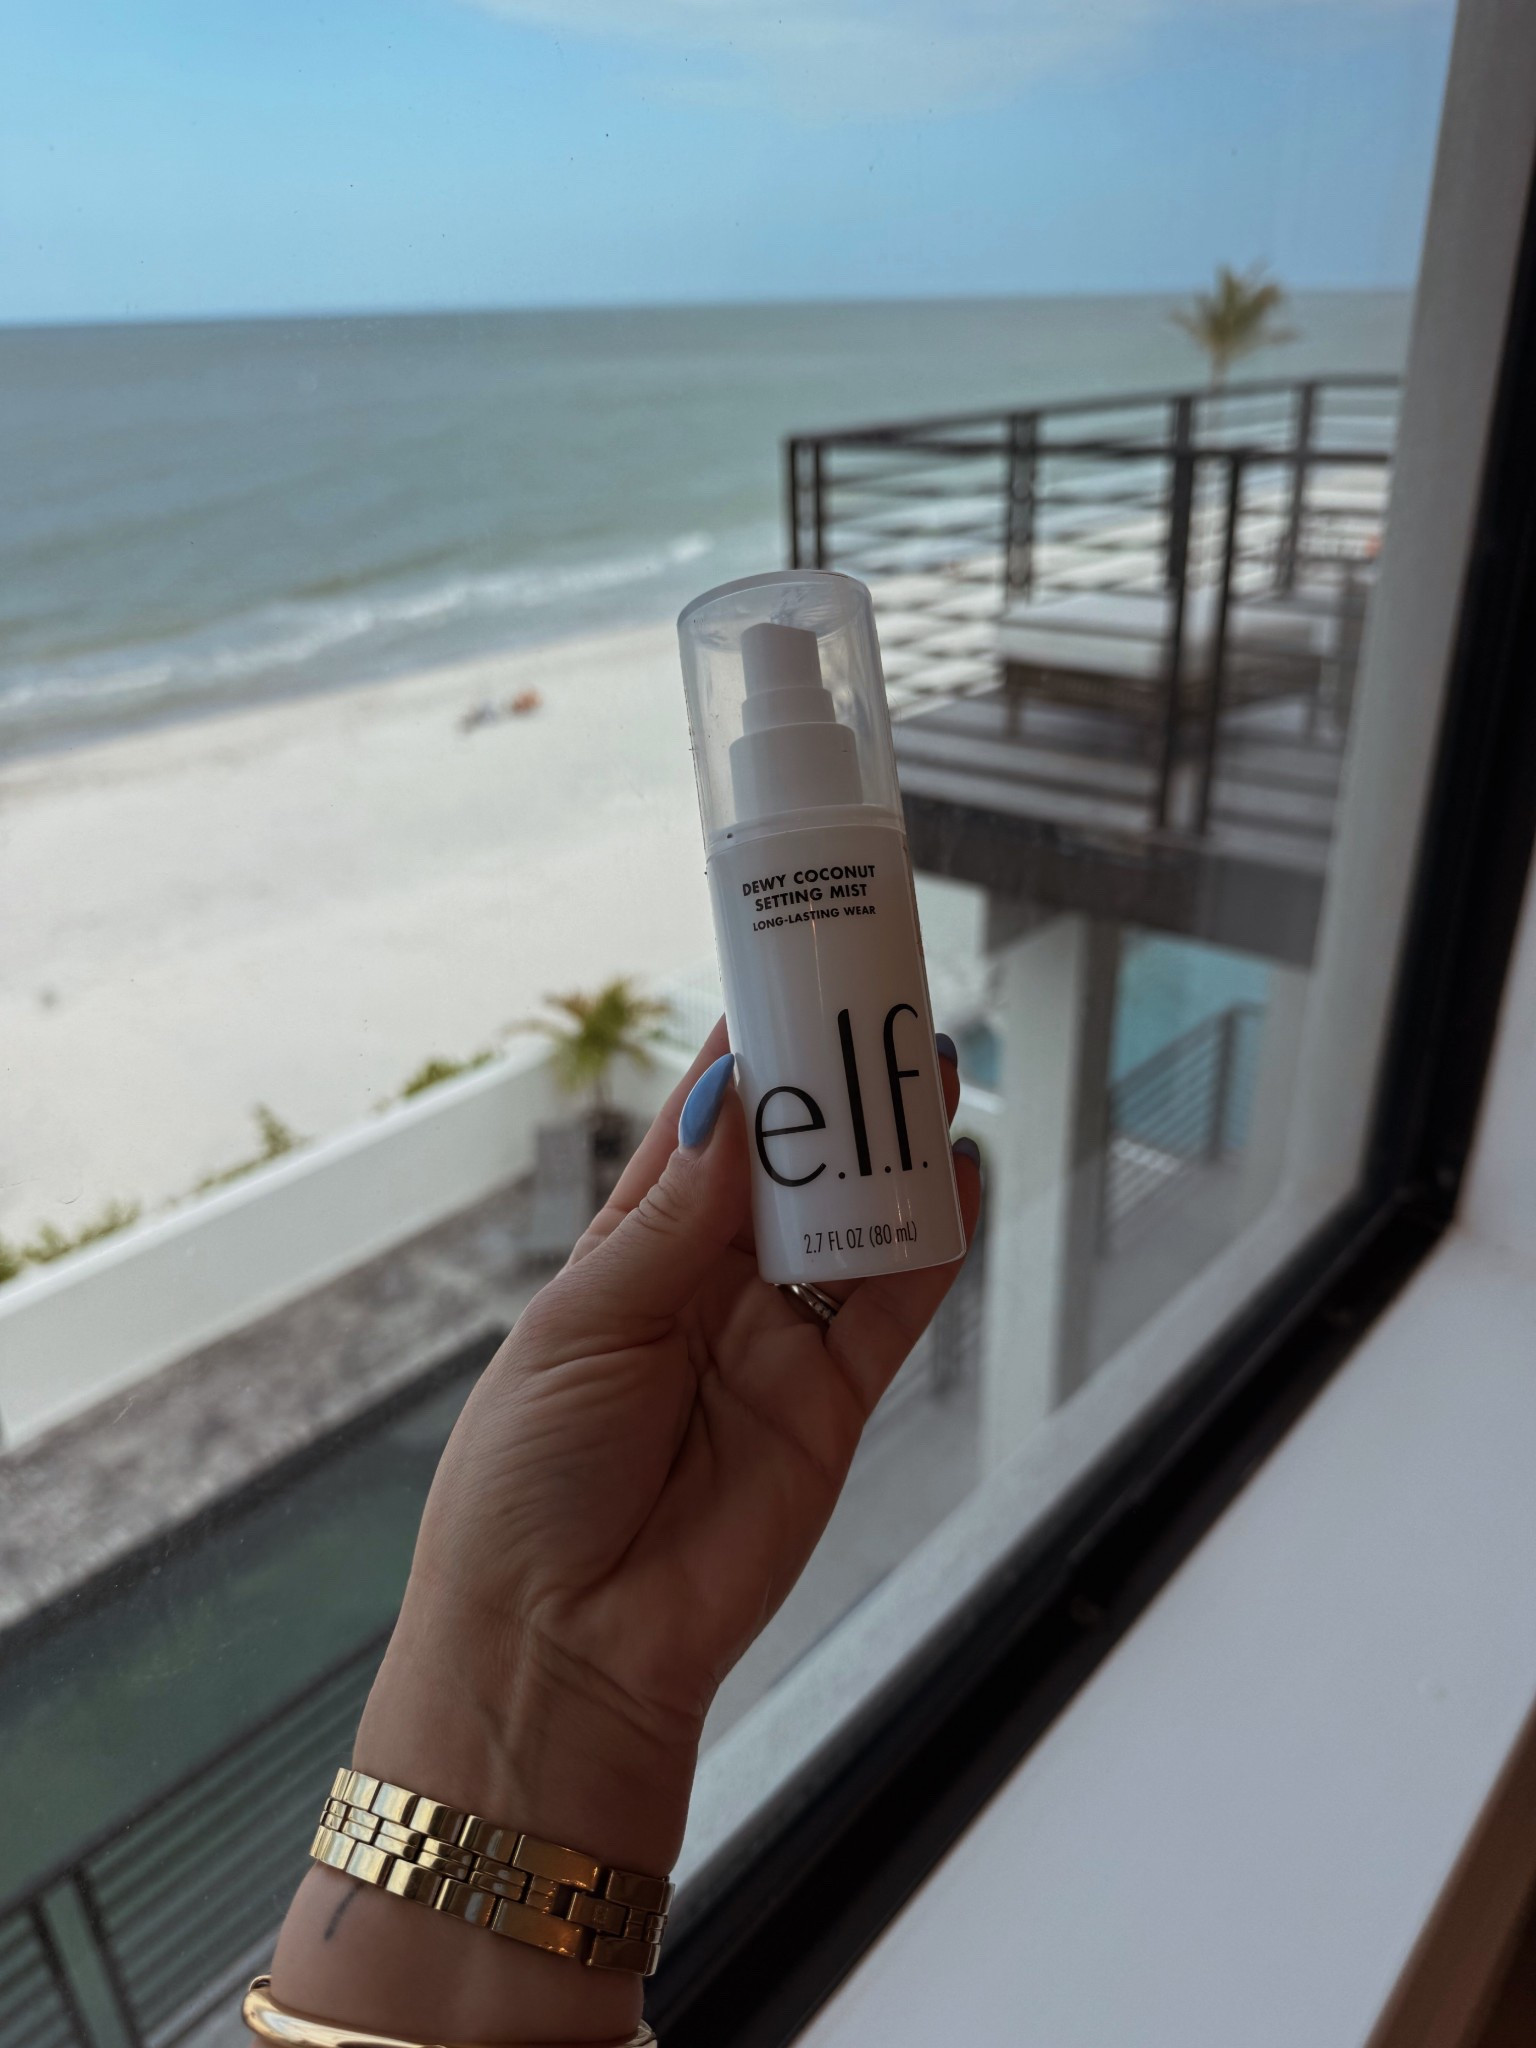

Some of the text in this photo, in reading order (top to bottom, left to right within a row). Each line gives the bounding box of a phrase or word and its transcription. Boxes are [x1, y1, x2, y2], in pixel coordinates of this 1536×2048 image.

[742, 865, 875, 896] DEWY COCONUT
[755, 883, 867, 912] SETTING MIST
[753, 905, 876, 931] LONG-LASTING WEAR
[755, 1003, 928, 1187] e.l.f.
[803, 1221, 917, 1254] 2.7 FL OZ (80 mL)
